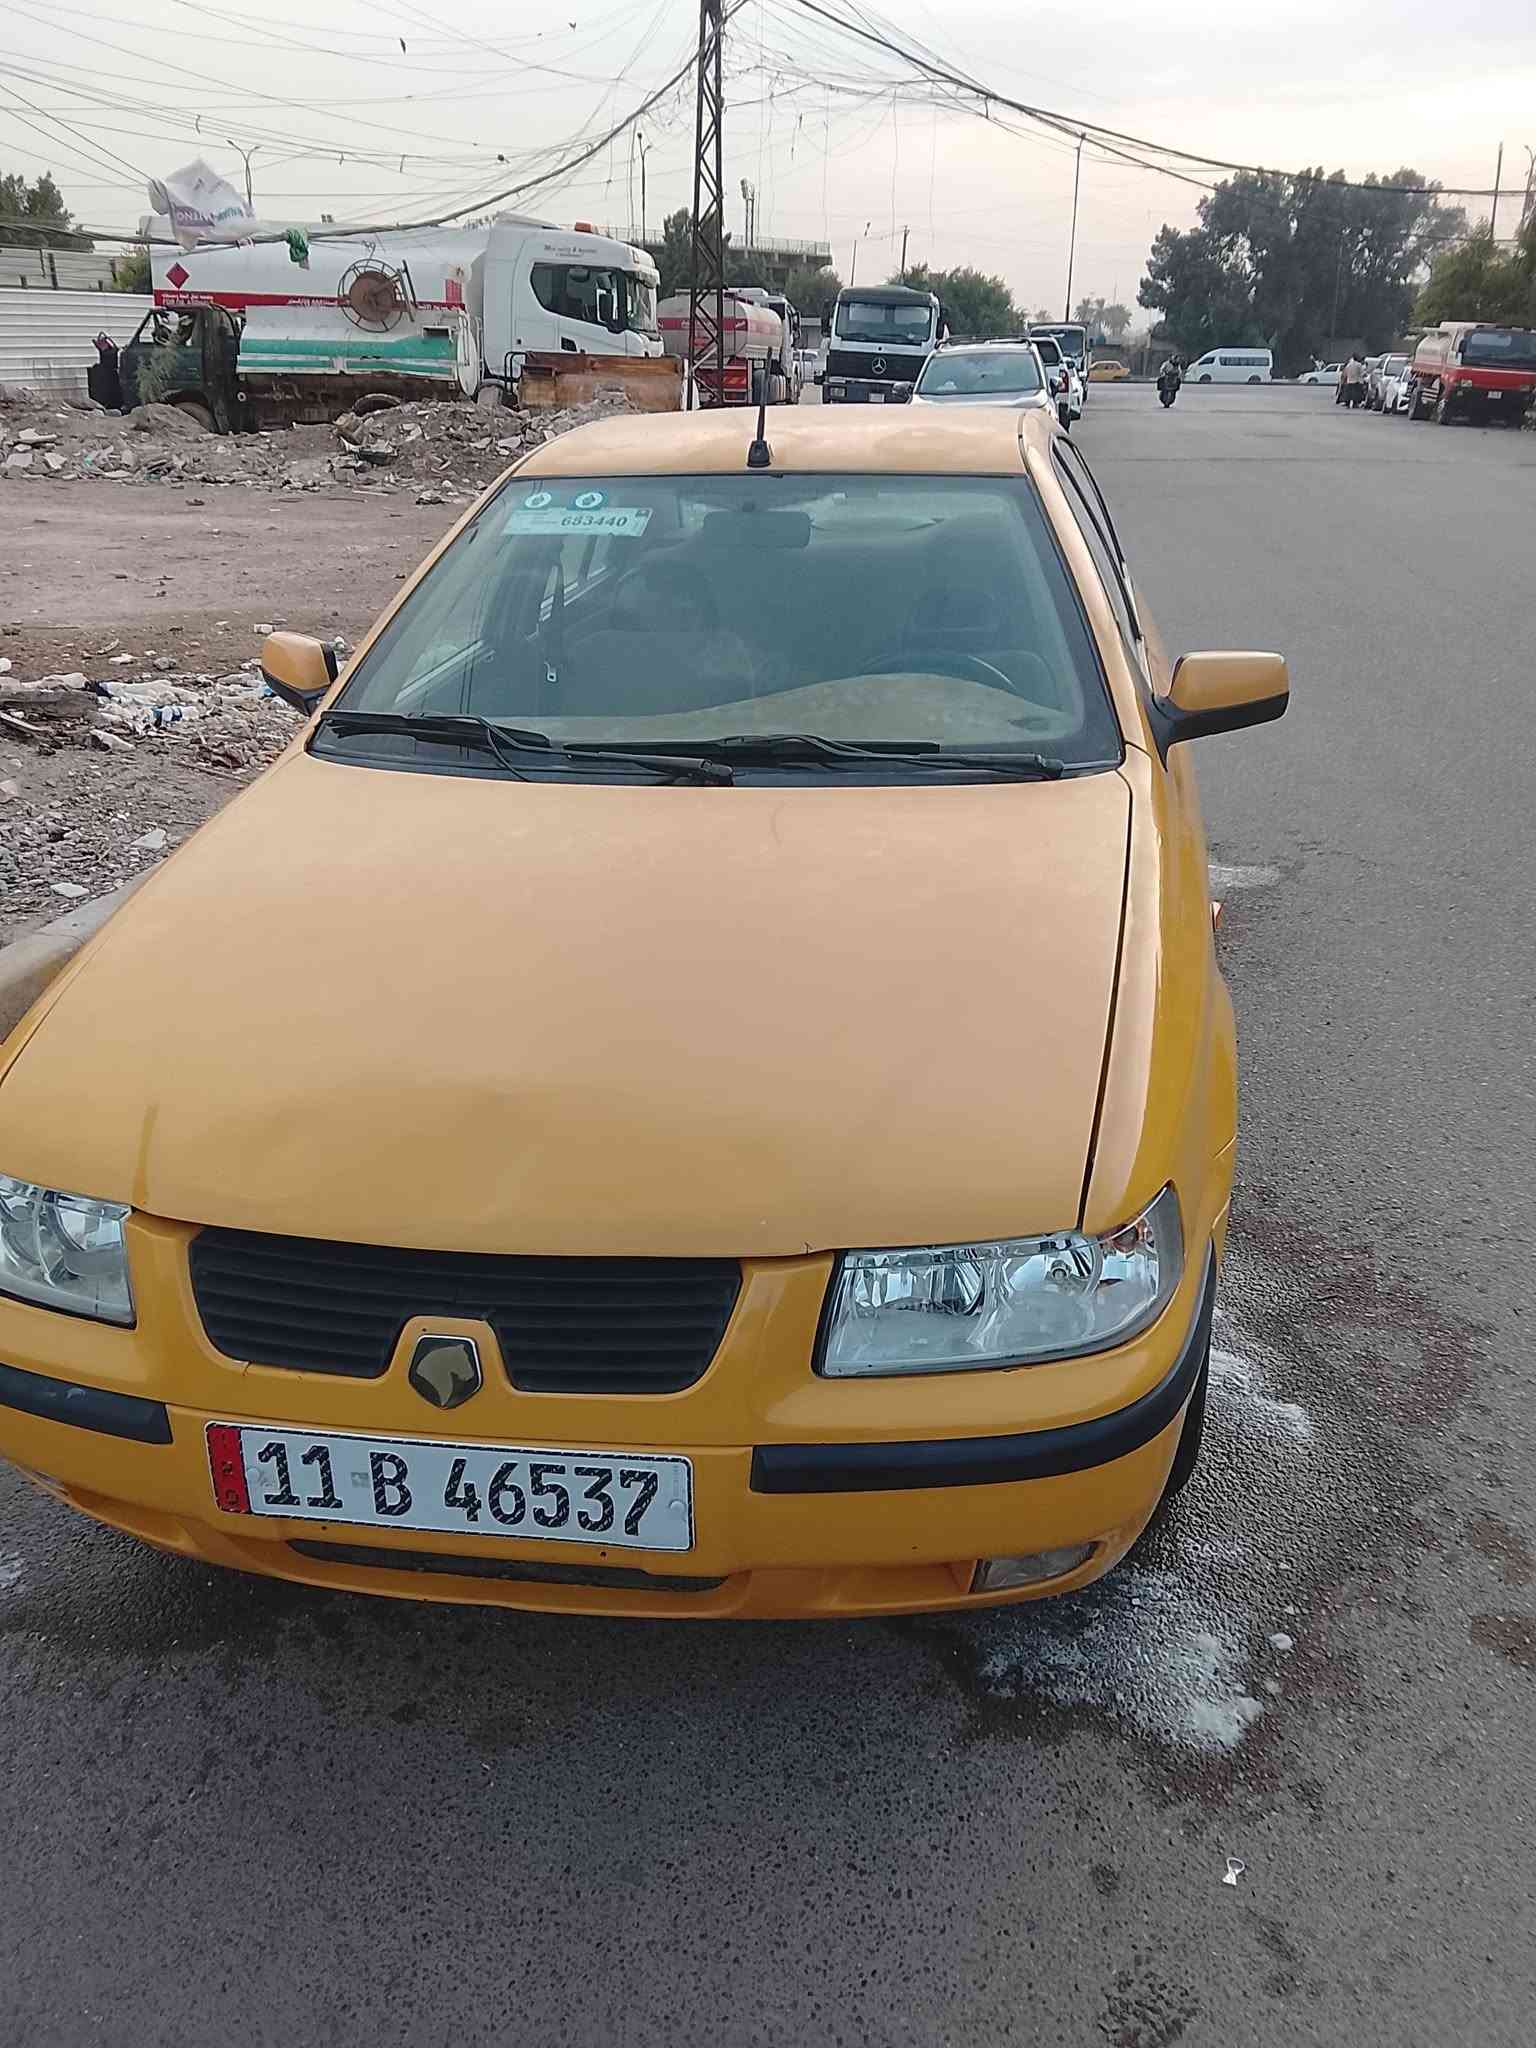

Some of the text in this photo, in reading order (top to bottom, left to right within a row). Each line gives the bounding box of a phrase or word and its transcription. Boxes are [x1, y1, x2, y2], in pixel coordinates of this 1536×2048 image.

[257, 1442, 660, 1537] 11 B 46537
